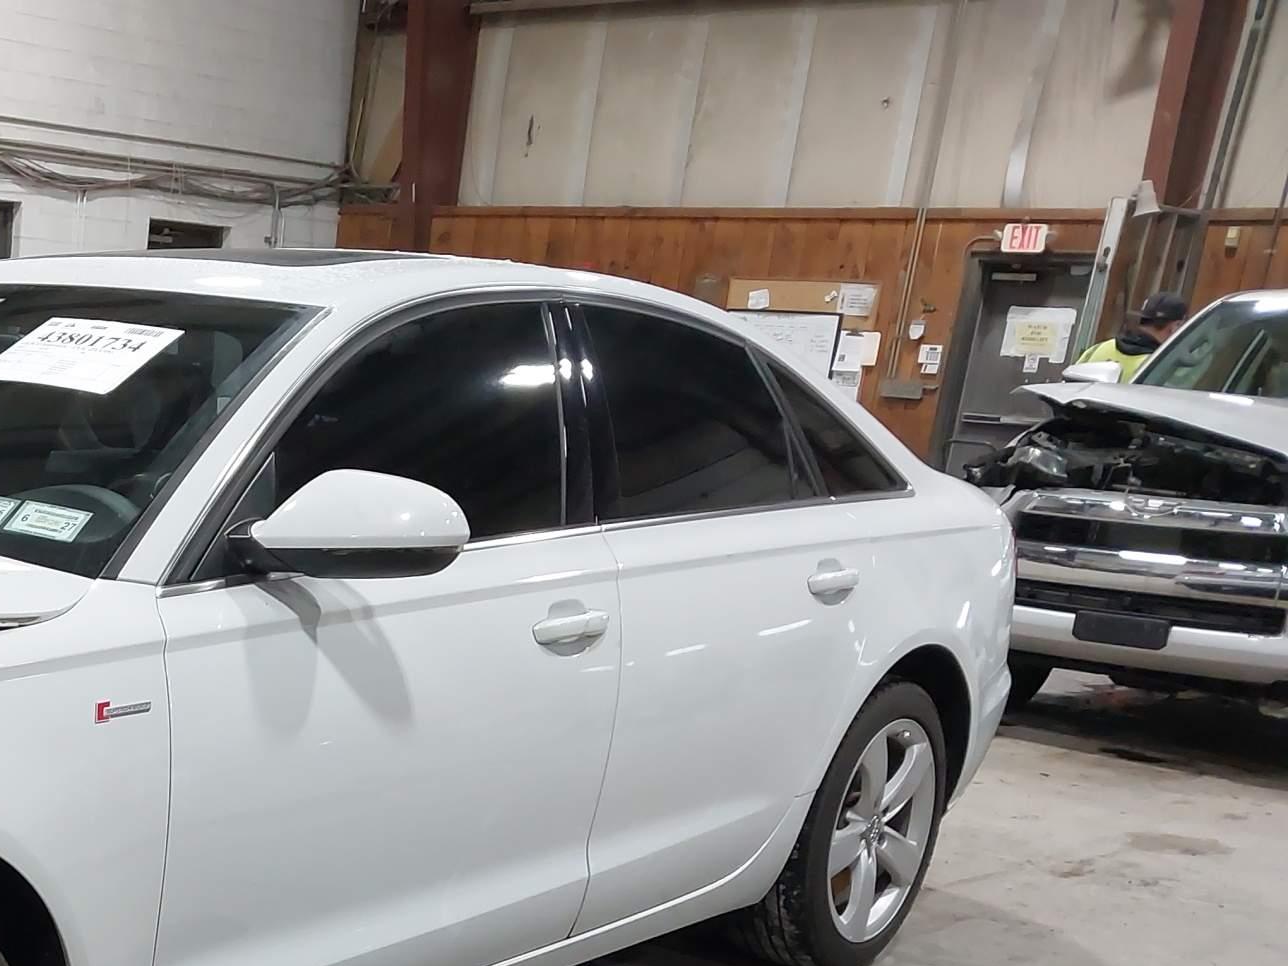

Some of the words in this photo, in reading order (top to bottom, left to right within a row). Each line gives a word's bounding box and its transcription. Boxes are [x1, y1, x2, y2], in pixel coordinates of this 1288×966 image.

[1009, 225, 1042, 250] EXIT
[37, 331, 147, 352] 43801734
[59, 521, 78, 532] 27
